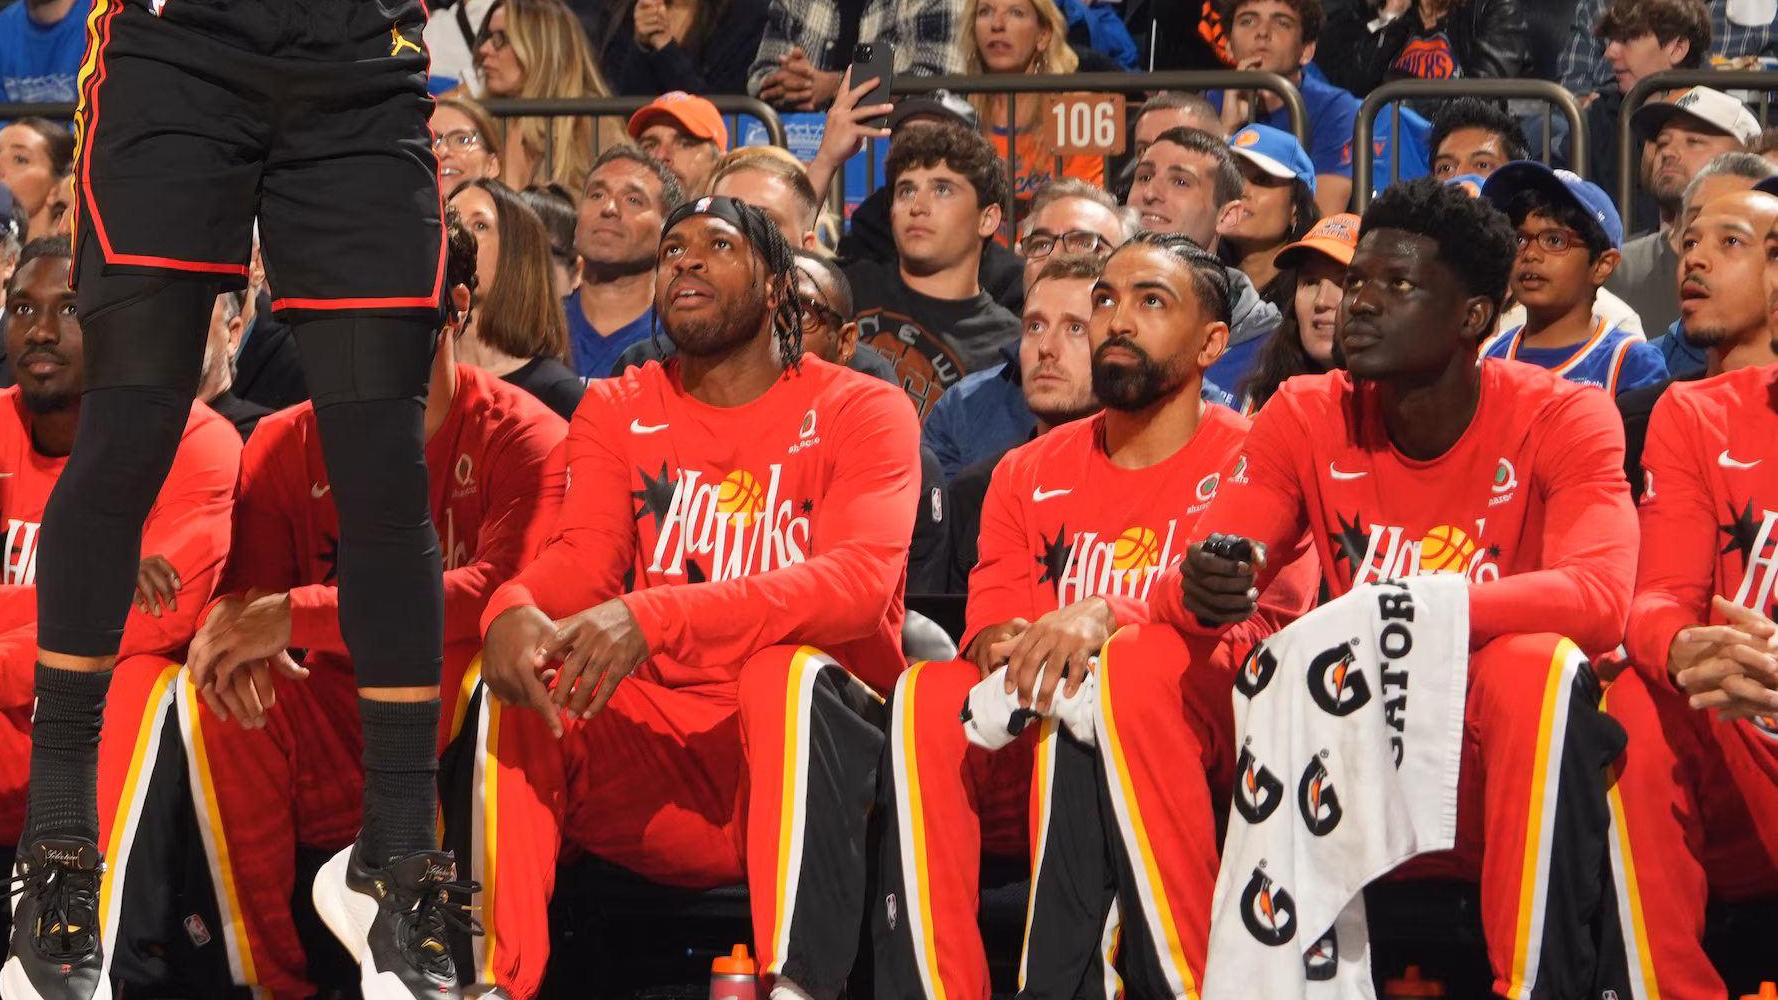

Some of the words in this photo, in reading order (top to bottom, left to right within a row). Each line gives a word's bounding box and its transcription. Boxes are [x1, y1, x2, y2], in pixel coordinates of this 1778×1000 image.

[1051, 102, 1116, 148] 106
[647, 462, 811, 584] Hawks
[1307, 640, 1373, 717] G
[1233, 744, 1284, 825] G
[1297, 752, 1343, 837] G
[1239, 865, 1298, 947] G
